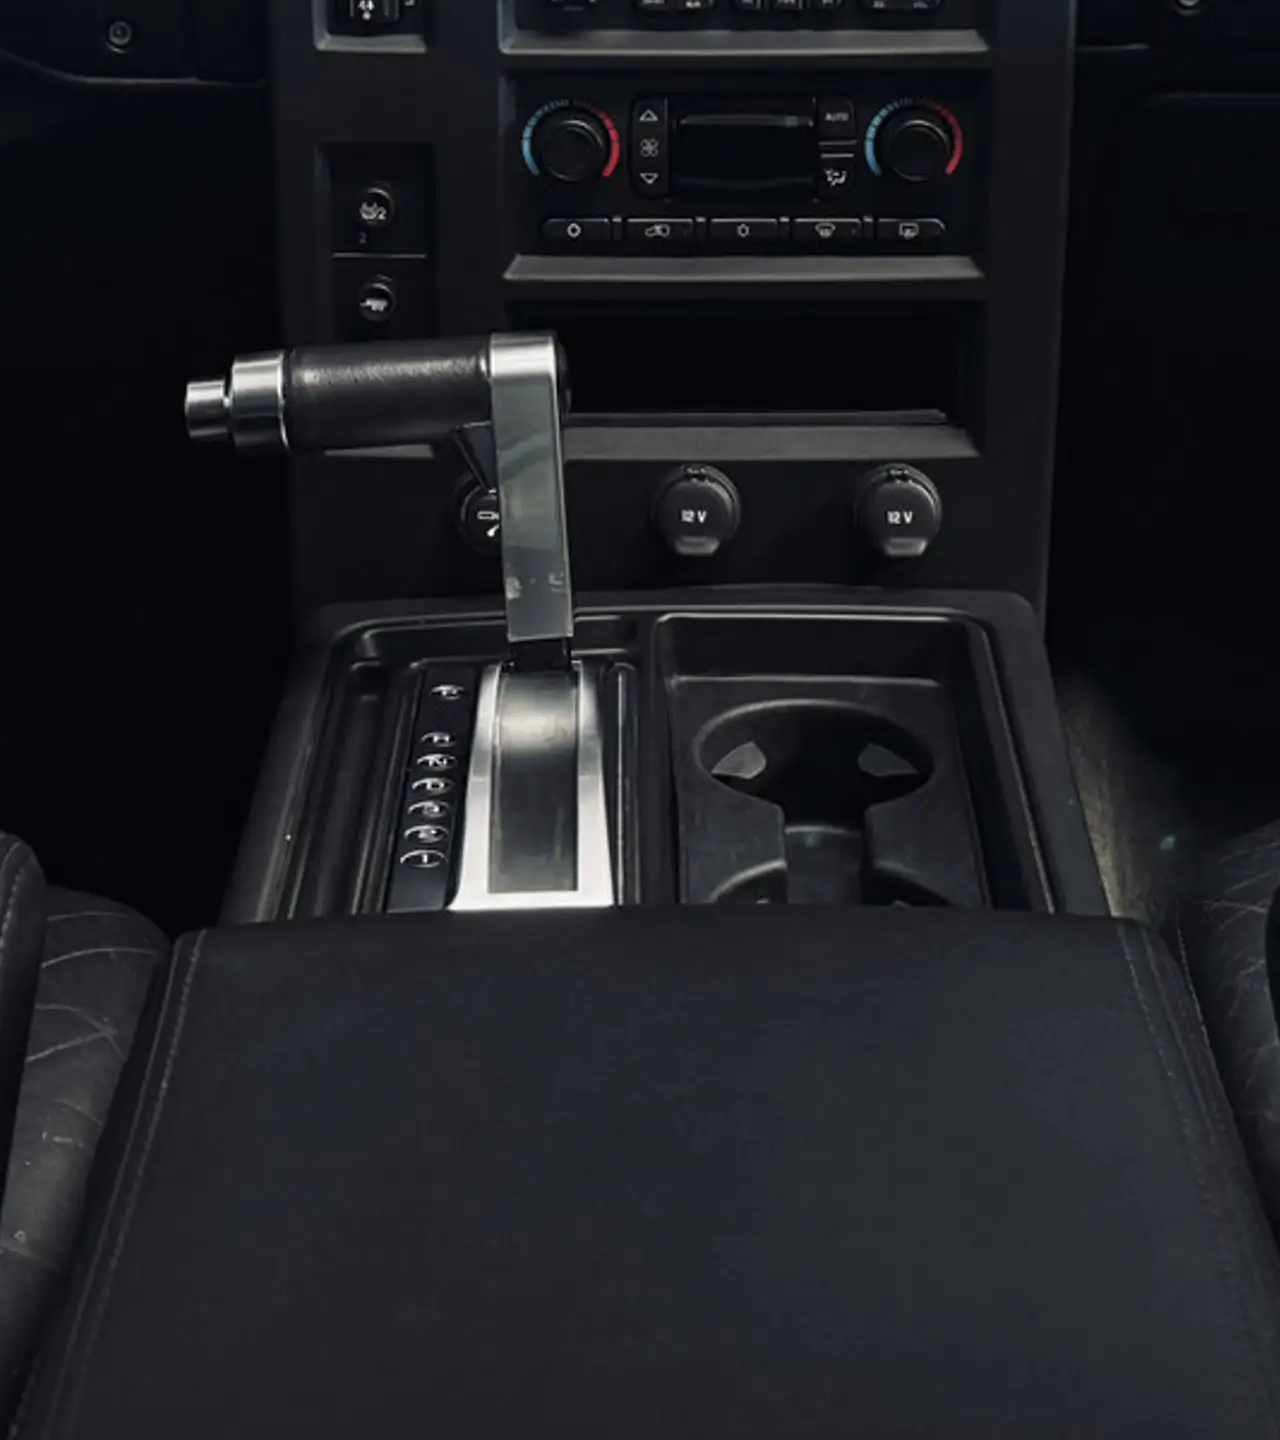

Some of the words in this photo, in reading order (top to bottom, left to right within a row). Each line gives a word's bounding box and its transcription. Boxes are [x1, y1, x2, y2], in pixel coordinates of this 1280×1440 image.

[823, 111, 850, 123] AUTO
[680, 509, 695, 523] 12
[697, 510, 708, 523] V
[886, 510, 901, 524] 12
[903, 511, 914, 524] V
